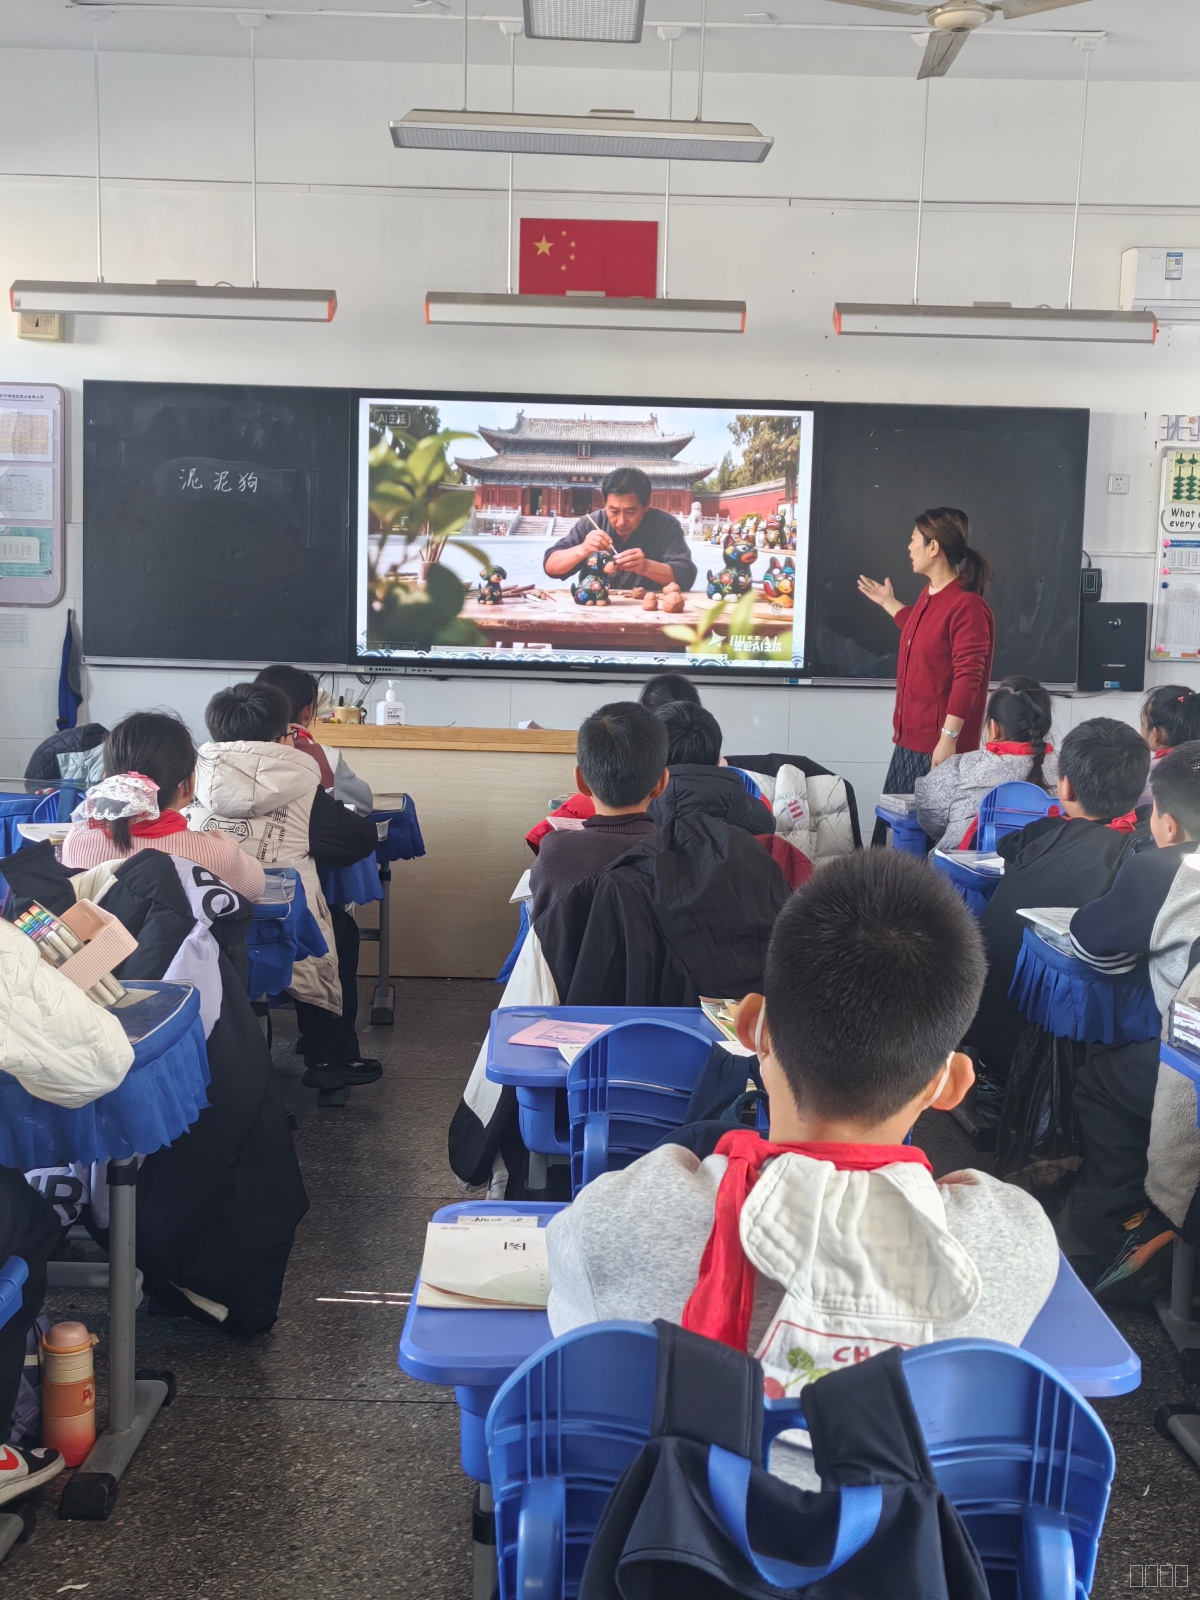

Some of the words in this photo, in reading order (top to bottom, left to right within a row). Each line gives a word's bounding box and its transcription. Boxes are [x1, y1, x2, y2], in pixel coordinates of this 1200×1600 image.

[179, 467, 258, 493] 泥泥狗
[1171, 507, 1195, 518] What
[1169, 520, 1195, 531] every
